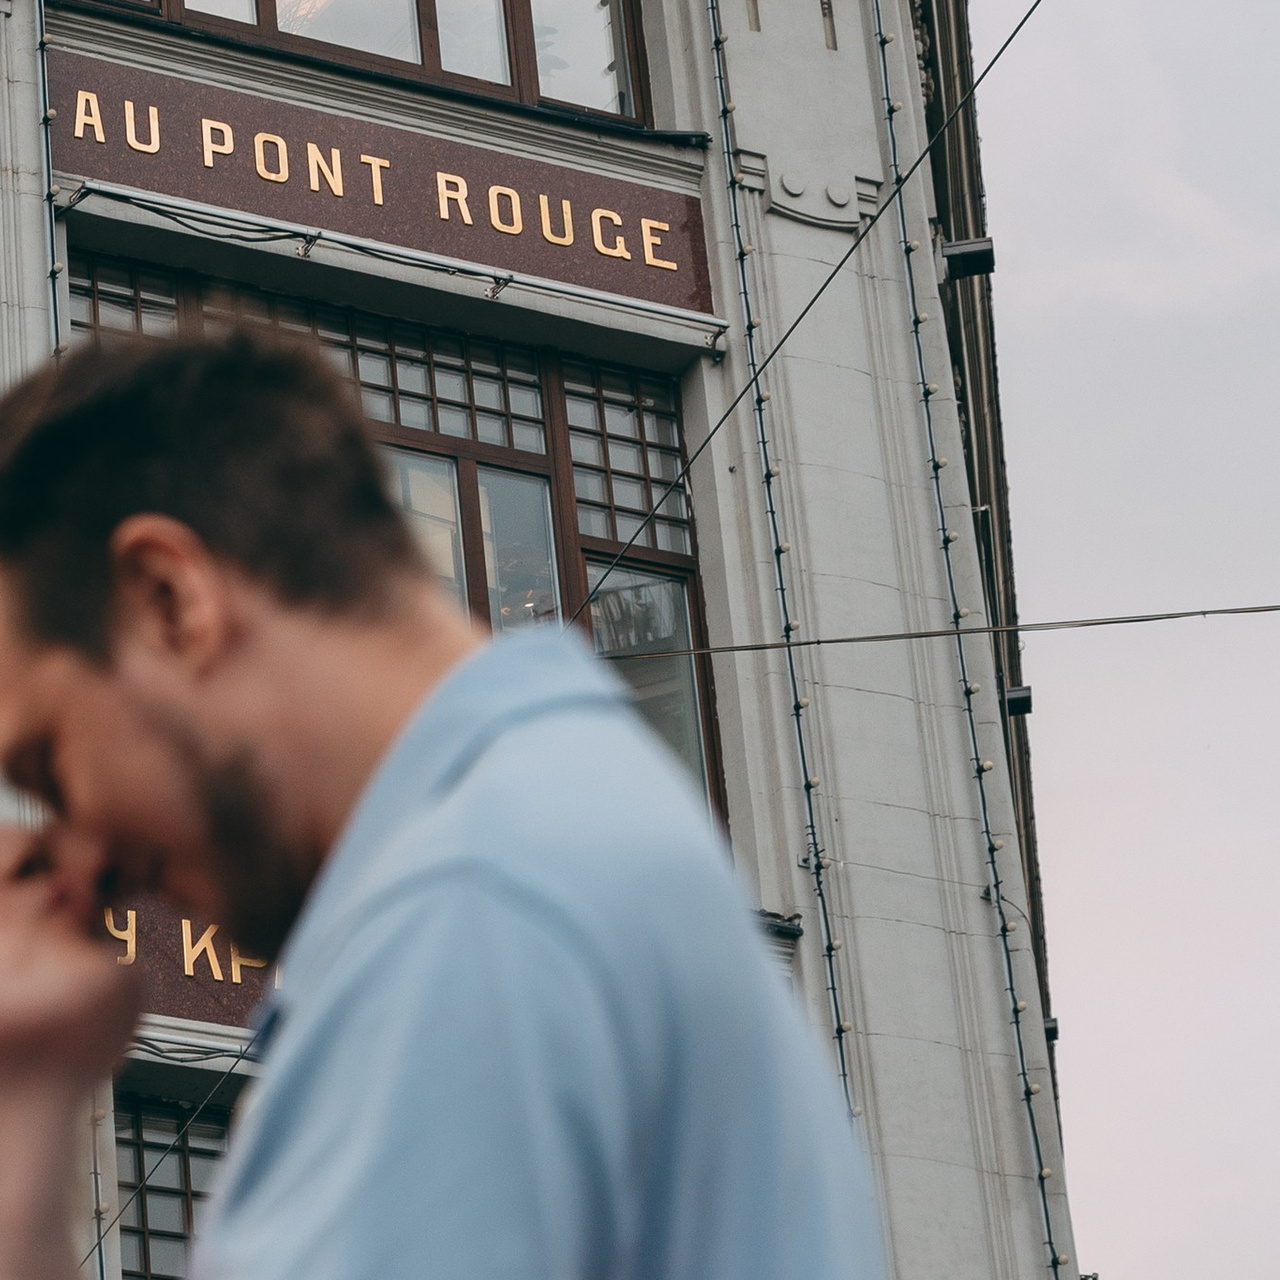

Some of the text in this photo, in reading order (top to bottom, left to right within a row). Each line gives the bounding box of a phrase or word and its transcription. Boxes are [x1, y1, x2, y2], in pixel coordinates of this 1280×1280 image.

[73, 89, 678, 271] AU PONT ROUGE
